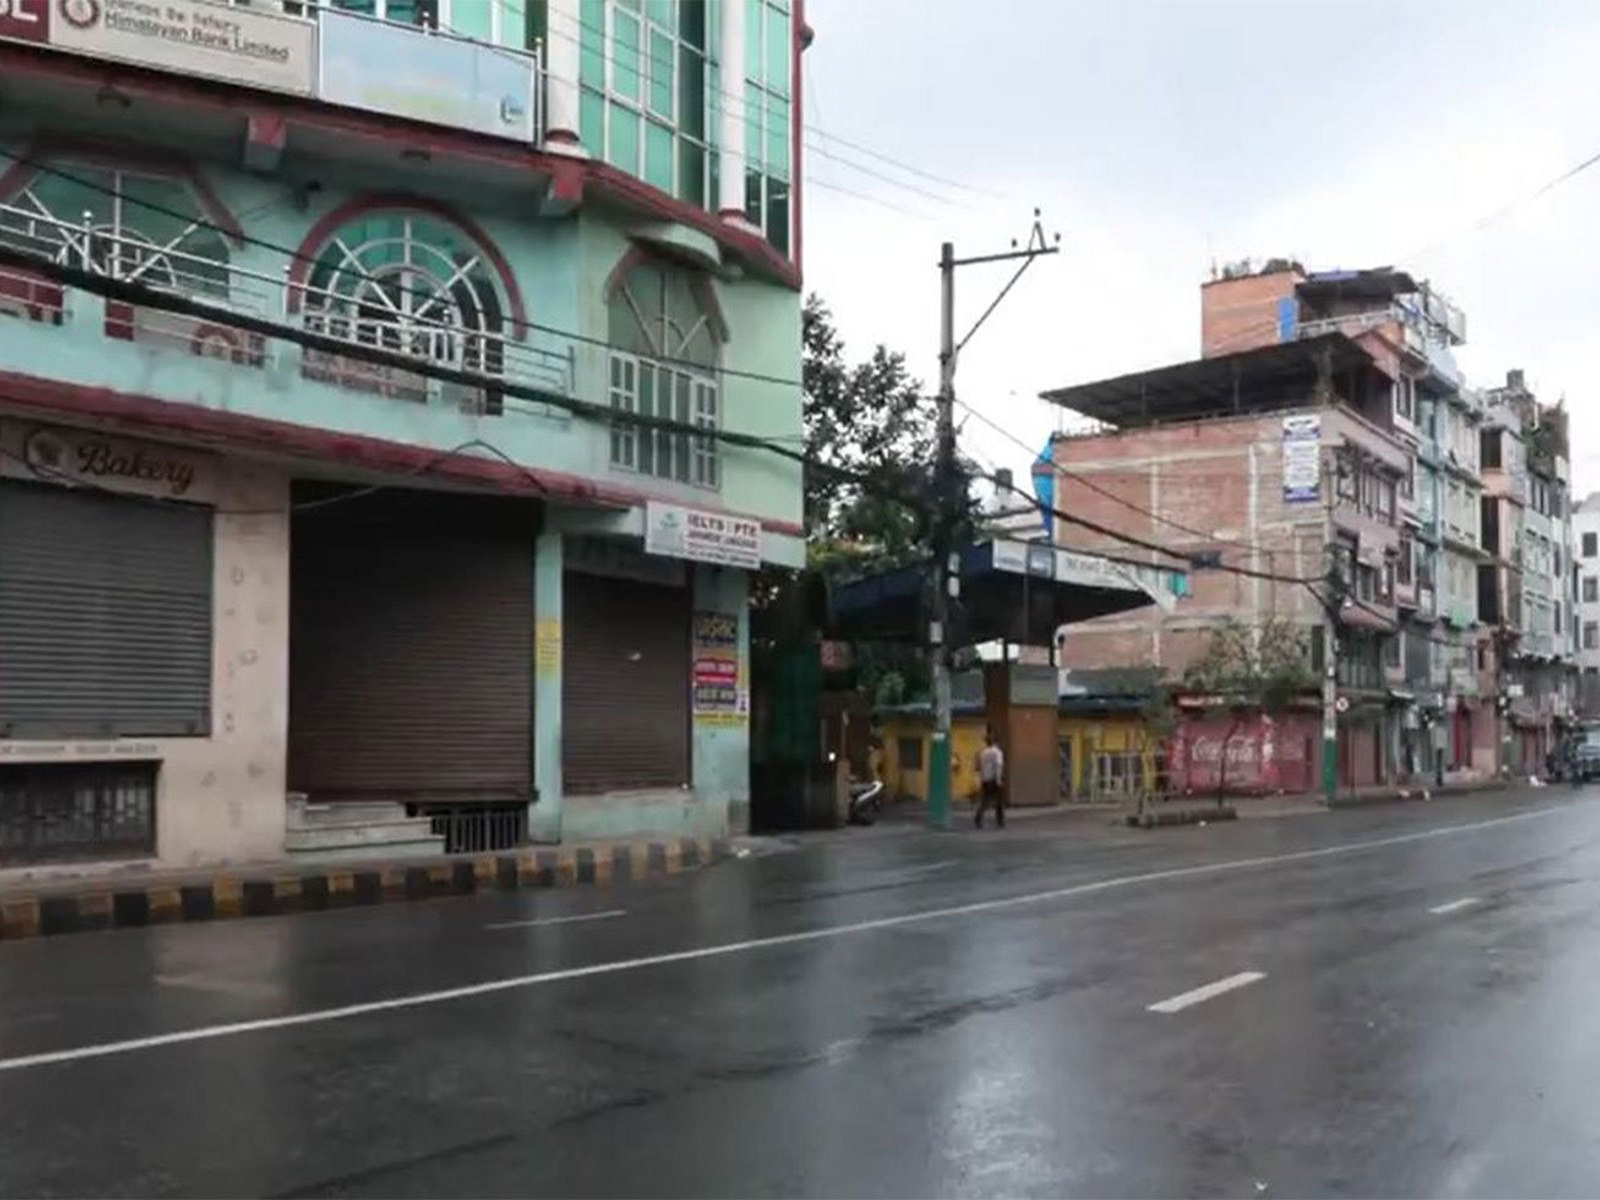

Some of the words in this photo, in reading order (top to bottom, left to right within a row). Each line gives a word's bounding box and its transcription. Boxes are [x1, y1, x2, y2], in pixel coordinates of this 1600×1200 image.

[105, 12, 188, 41] Himalayan
[192, 26, 229, 48] Bank
[234, 25, 291, 62] Limited
[78, 442, 195, 496] Bakery
[688, 512, 725, 532] IELTS
[734, 523, 758, 537] PTE
[1191, 735, 1256, 763] CocaCola
